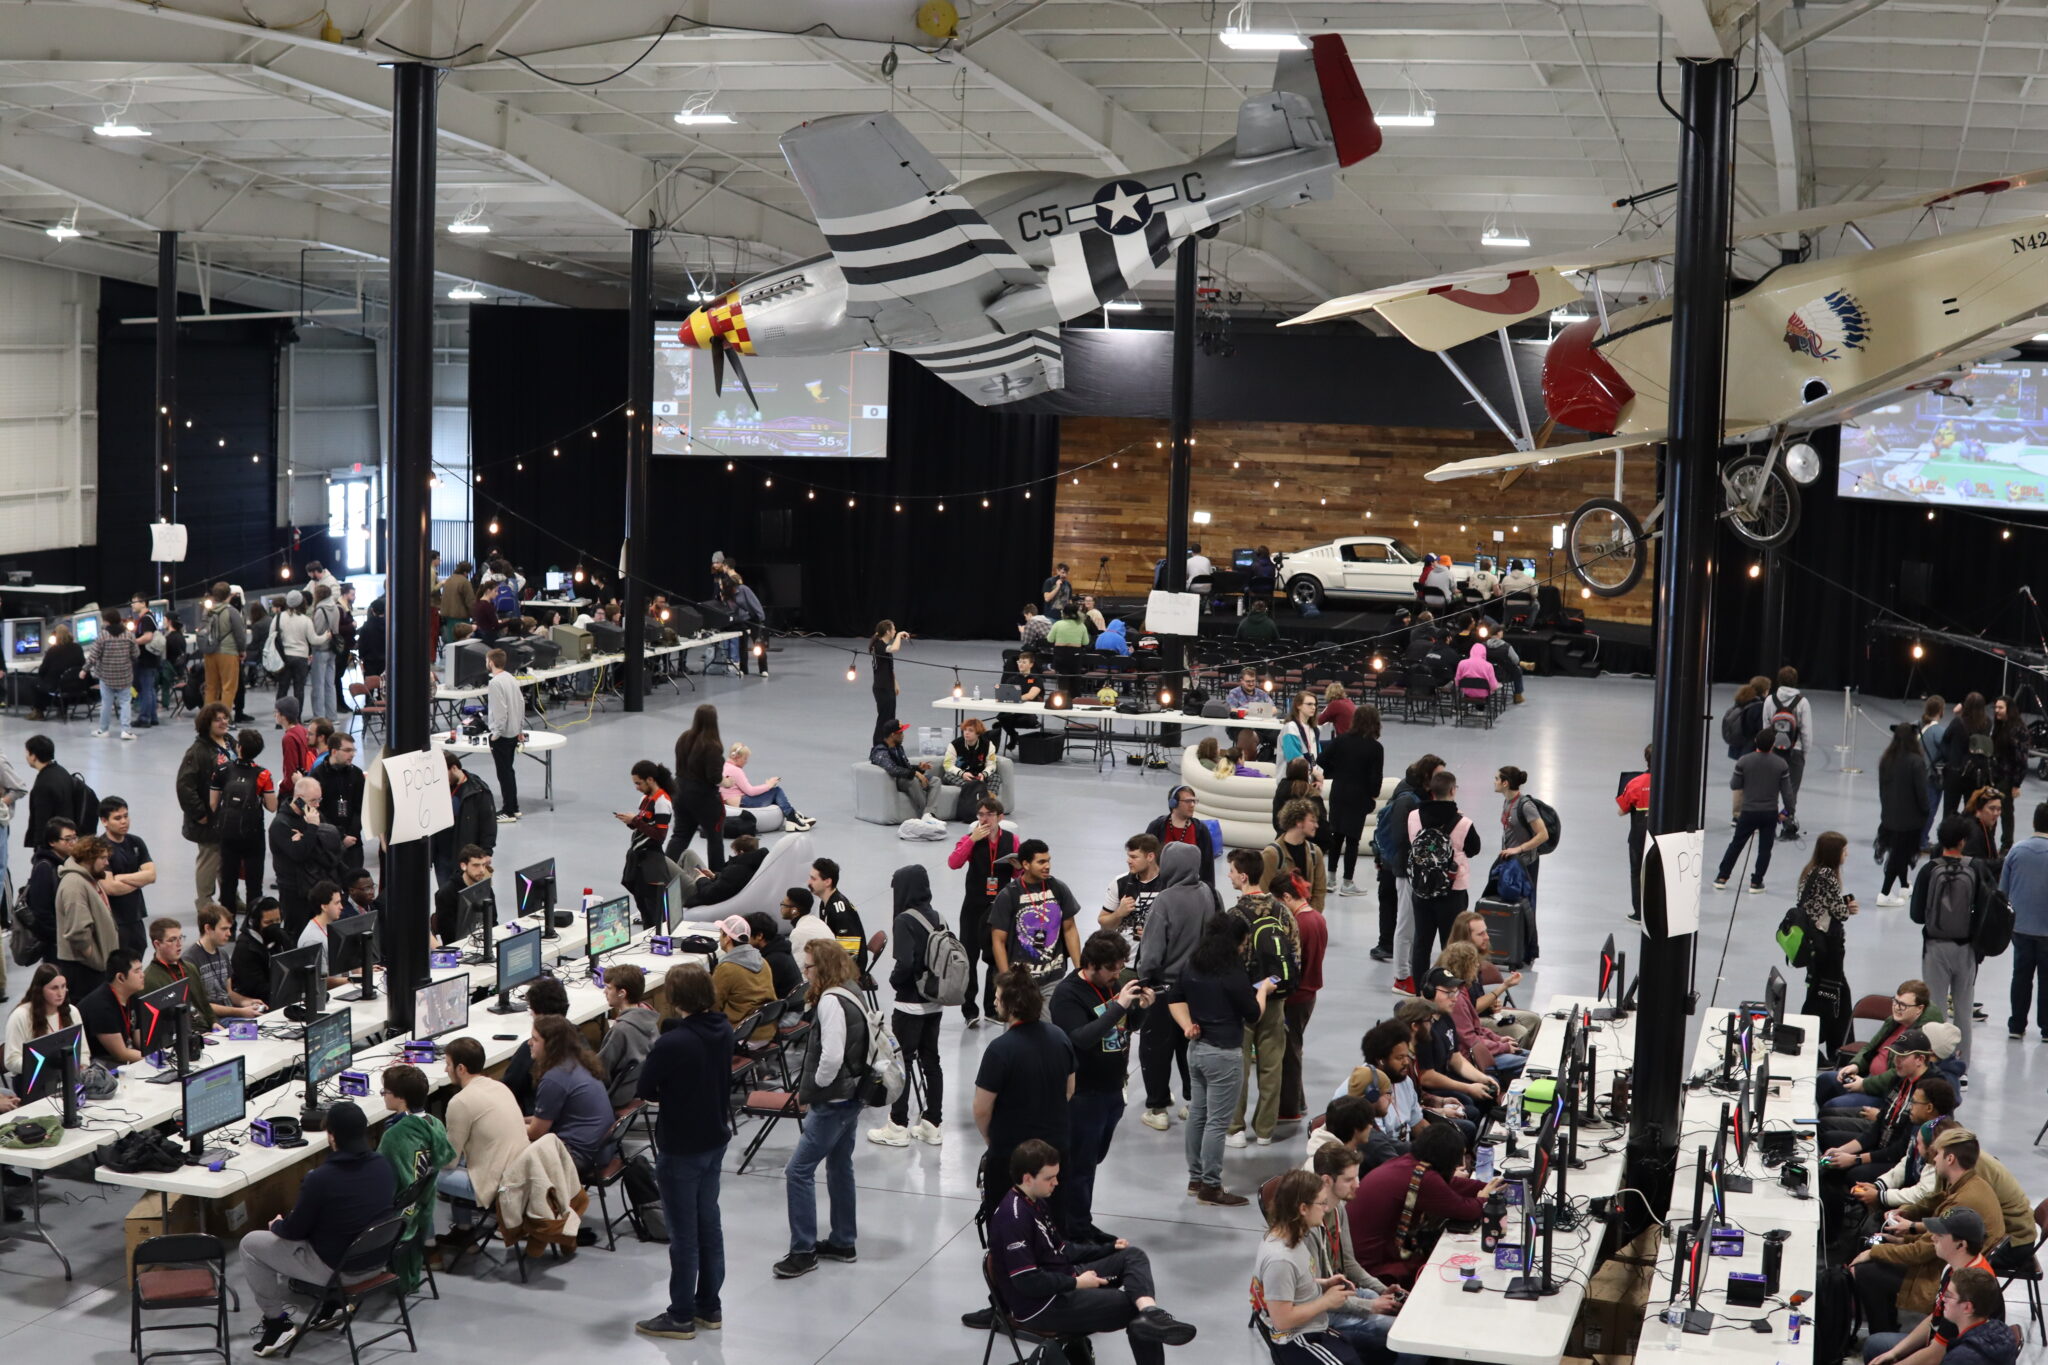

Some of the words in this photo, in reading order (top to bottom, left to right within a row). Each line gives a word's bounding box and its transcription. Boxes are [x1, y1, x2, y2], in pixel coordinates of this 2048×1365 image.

[1018, 205, 1063, 242] C5
[1182, 172, 1206, 203] C
[2011, 231, 2048, 254] N42
[661, 404, 671, 413] 0
[870, 407, 879, 417] 0
[403, 766, 441, 798] POOL
[418, 792, 431, 829] 6
[833, 900, 846, 913] 10
